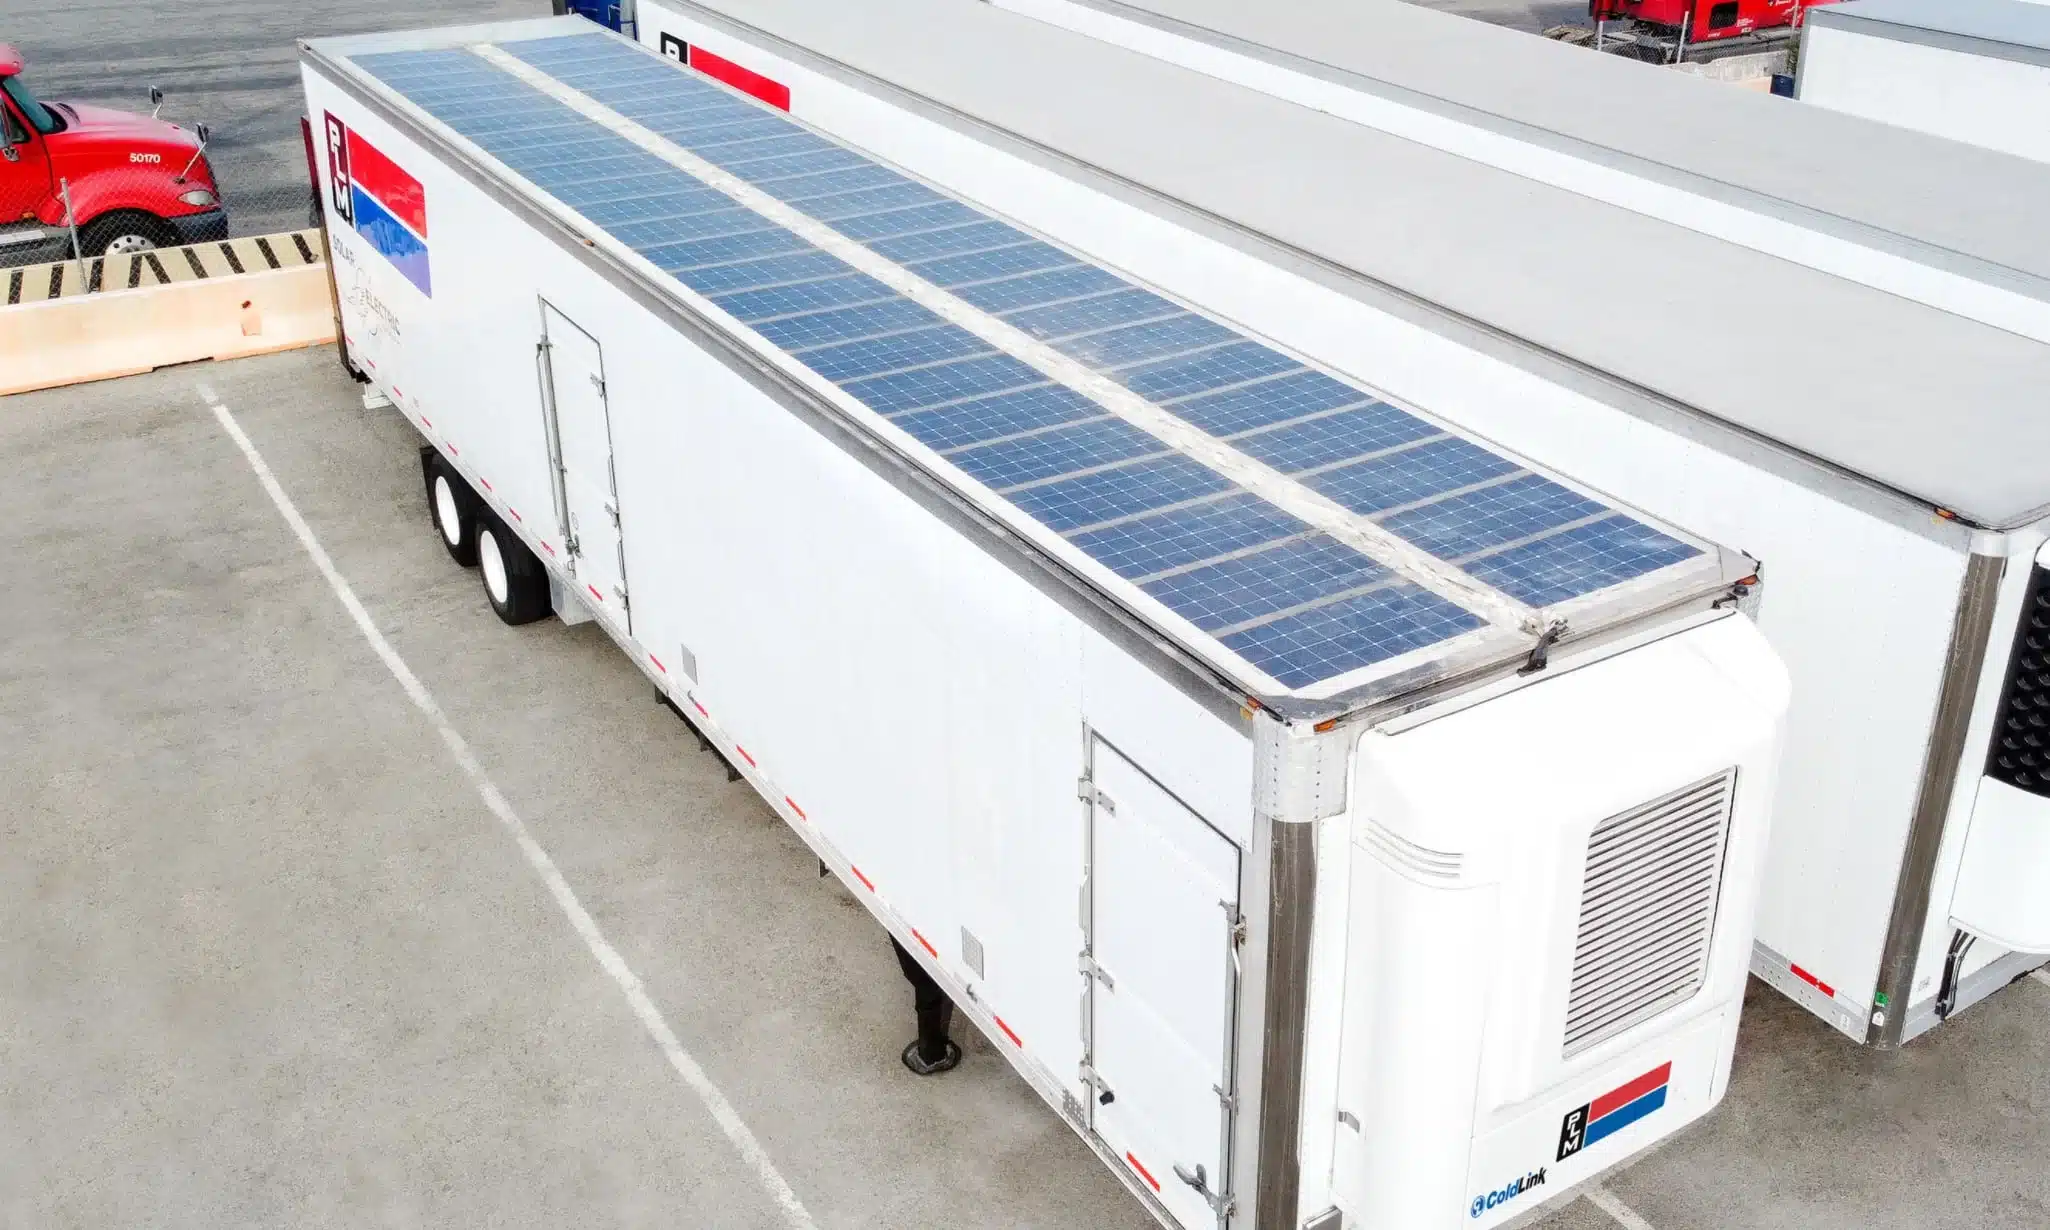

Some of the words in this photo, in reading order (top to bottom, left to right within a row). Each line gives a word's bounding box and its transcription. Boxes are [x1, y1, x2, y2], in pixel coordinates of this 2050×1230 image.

[129, 152, 161, 164] 50170
[328, 119, 351, 217] PLM
[1562, 1111, 1581, 1157] PLM
[1486, 1166, 1547, 1209] ColdLink
